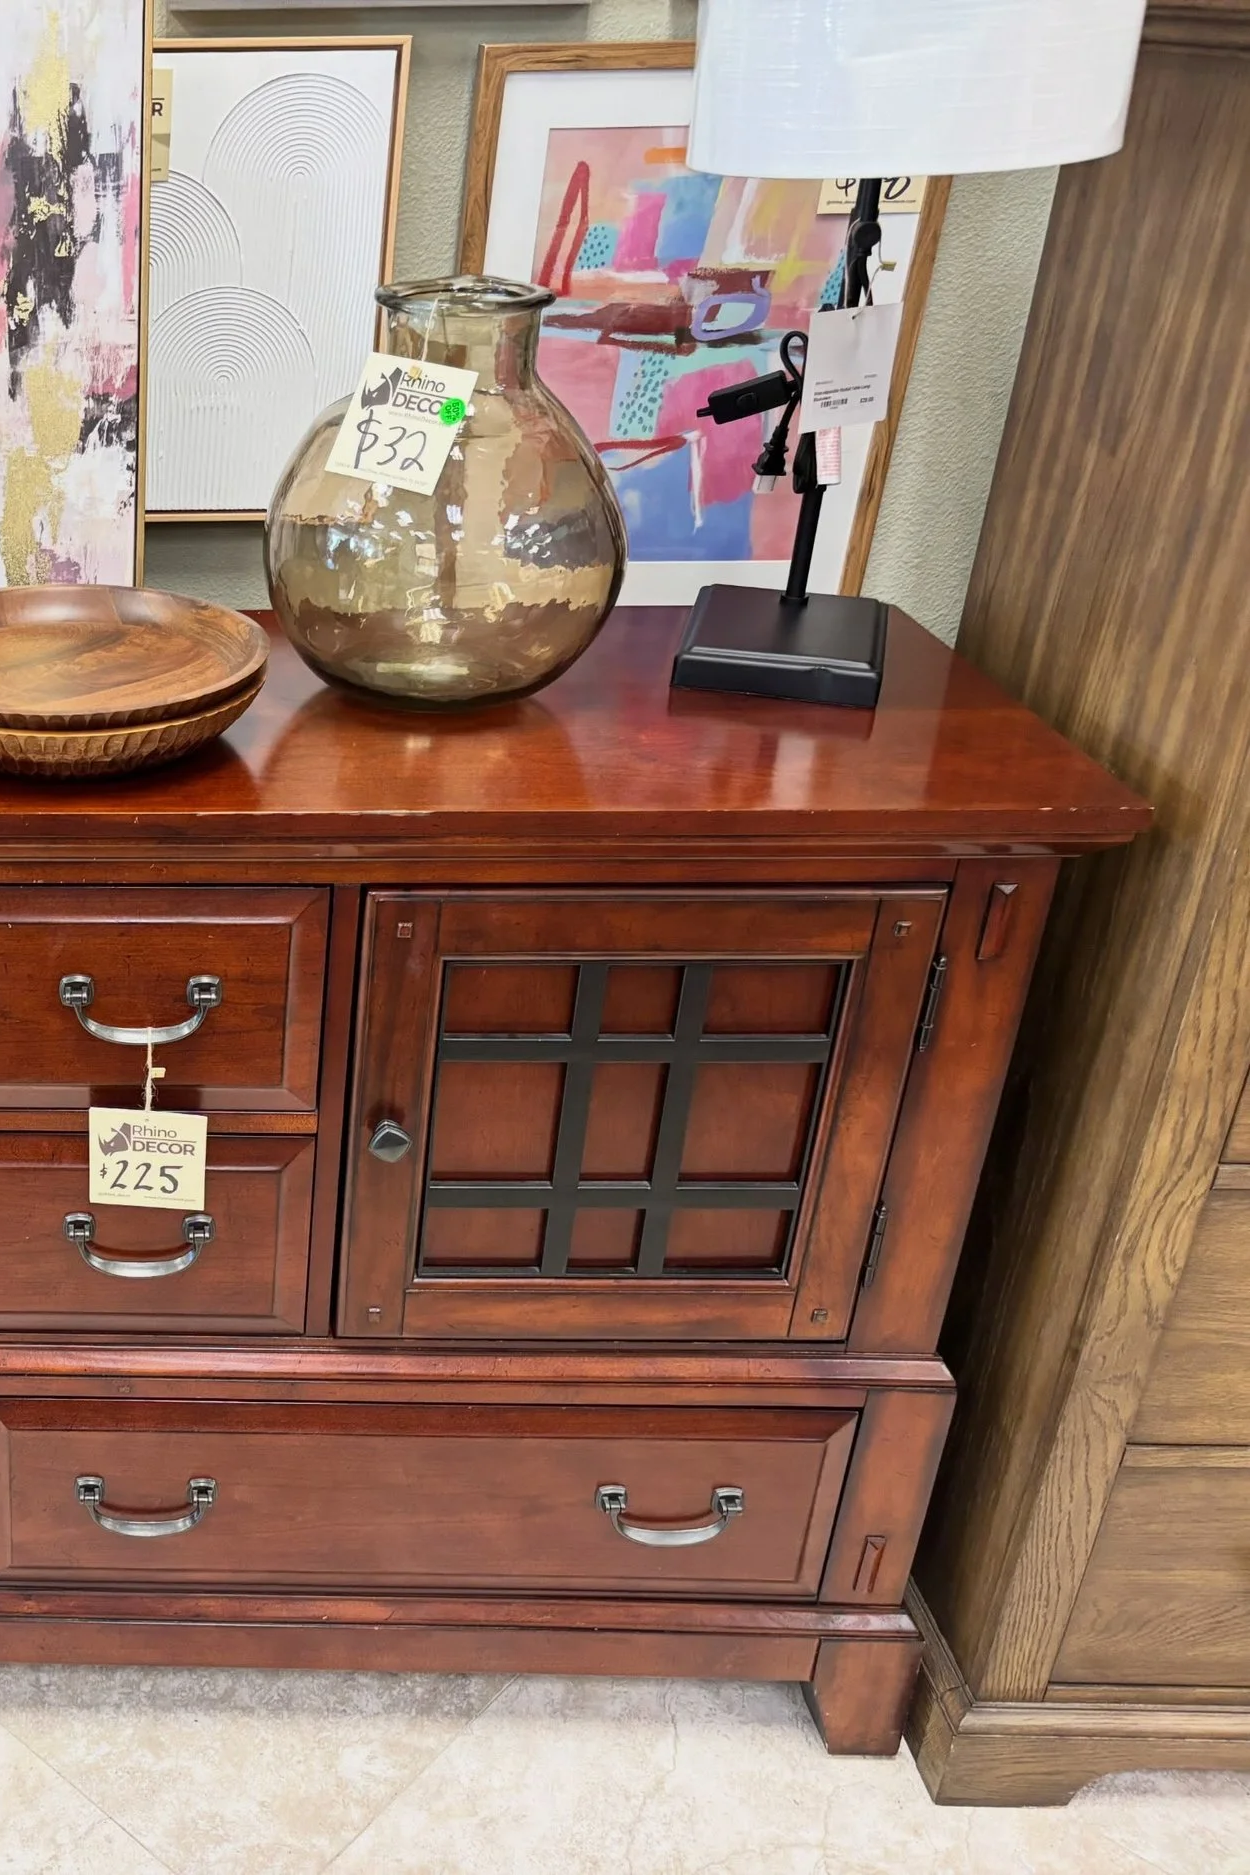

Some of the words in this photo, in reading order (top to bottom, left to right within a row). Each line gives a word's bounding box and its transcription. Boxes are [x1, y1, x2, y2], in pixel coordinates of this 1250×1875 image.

[392, 391, 444, 416] DECO
[354, 409, 427, 472] $32
[132, 1124, 177, 1138] Rhino
[132, 1140, 196, 1156] DECOR
[100, 1160, 184, 1194] $225
